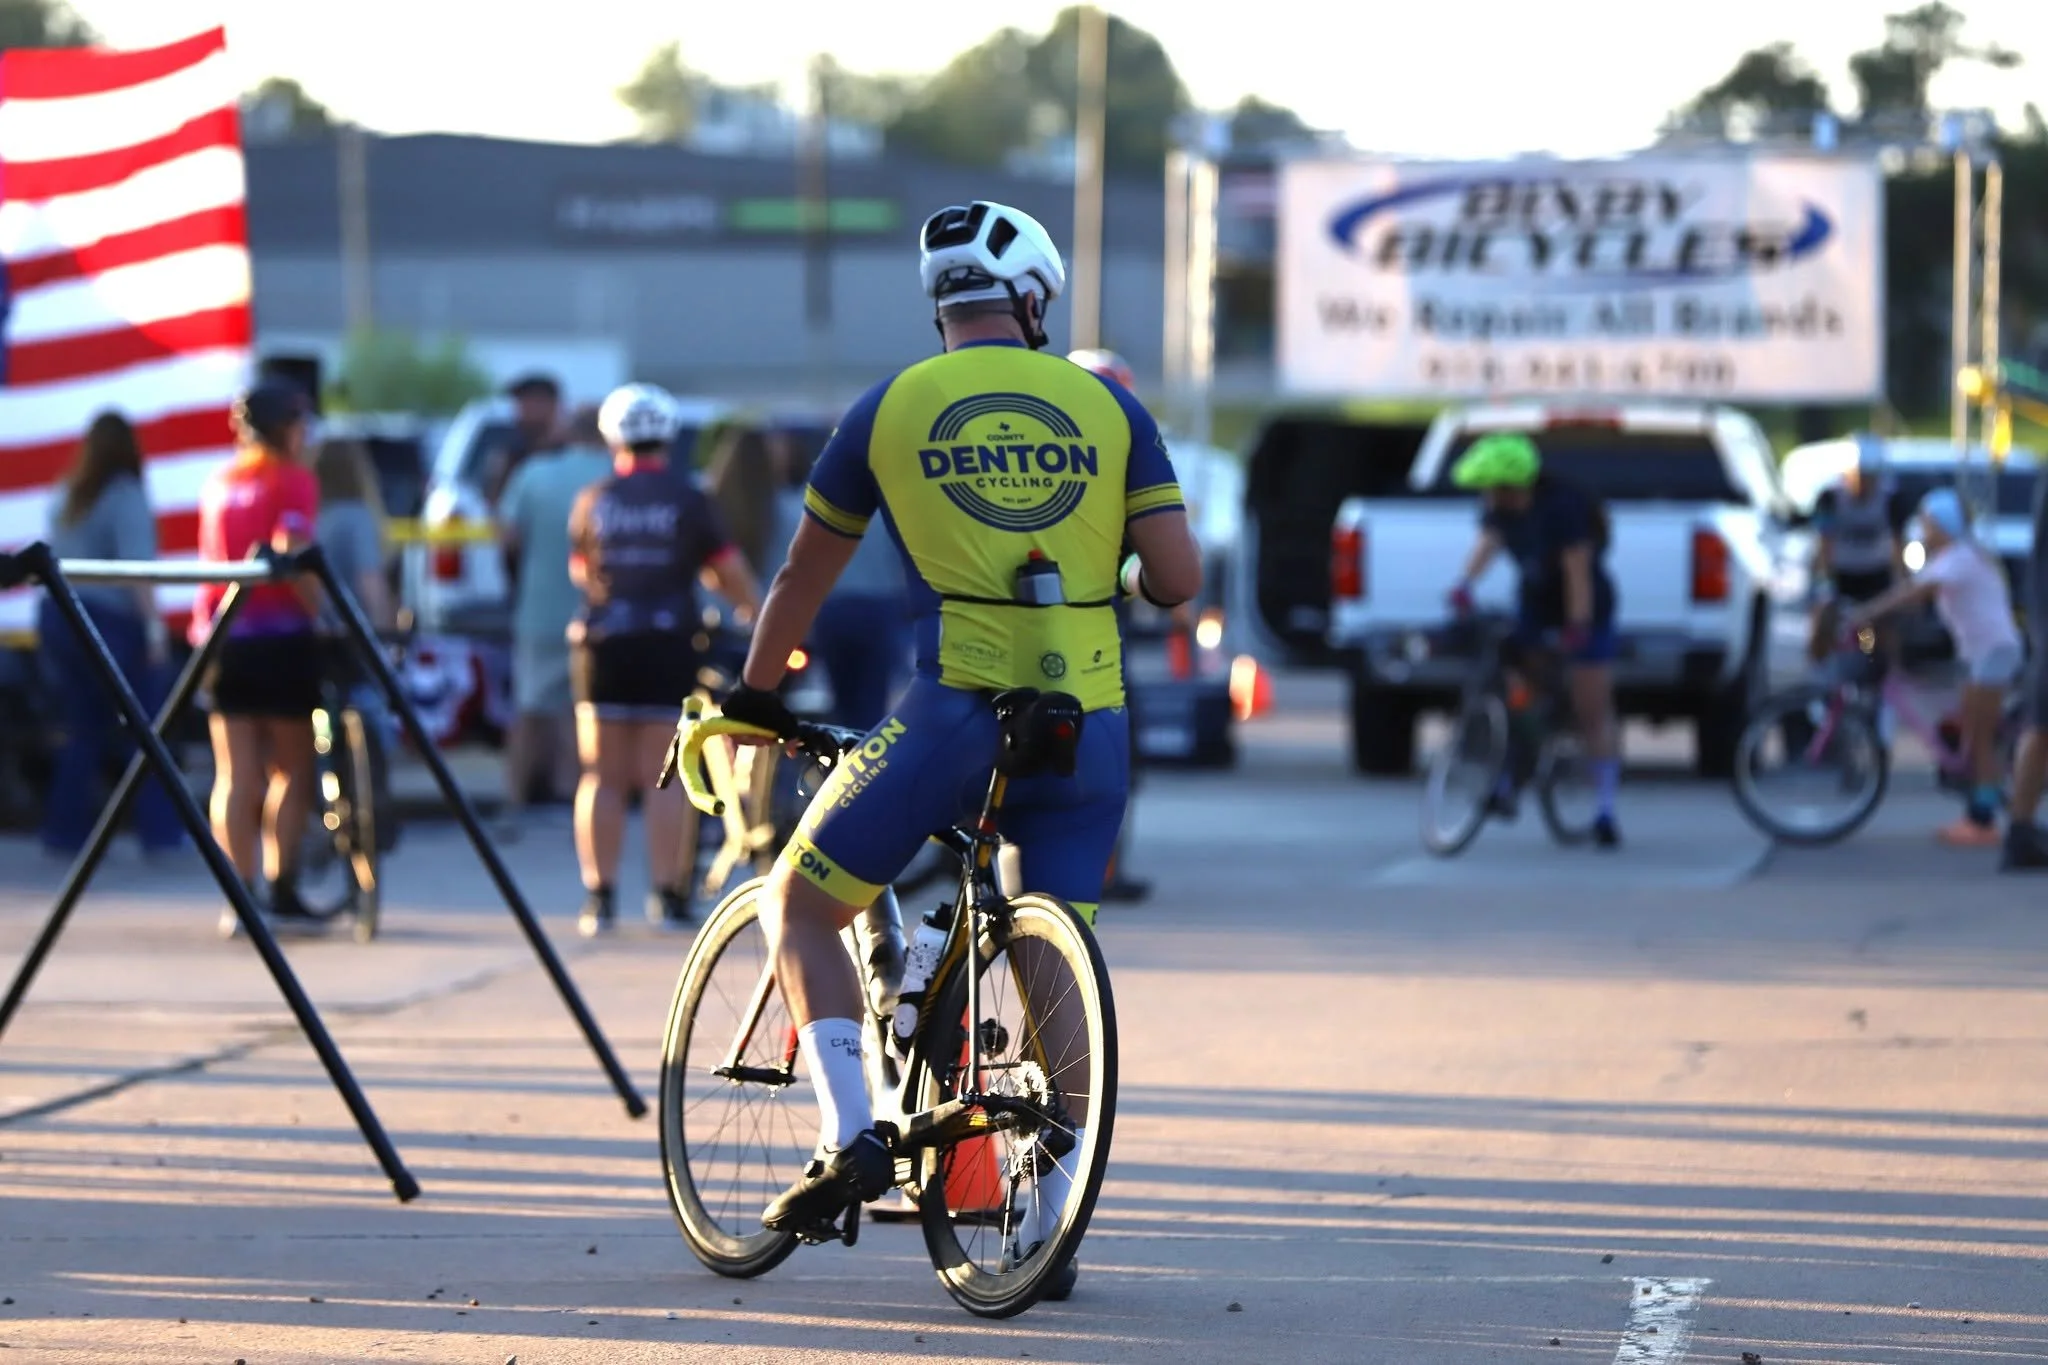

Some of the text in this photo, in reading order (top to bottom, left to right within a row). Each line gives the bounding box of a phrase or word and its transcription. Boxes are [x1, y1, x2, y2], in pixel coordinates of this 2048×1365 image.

[1320, 296, 1844, 340] We Repair All Brands
[918, 443, 1098, 480] DENTON
[976, 477, 1053, 489] CYCLING
[839, 760, 888, 809] CYCLING
